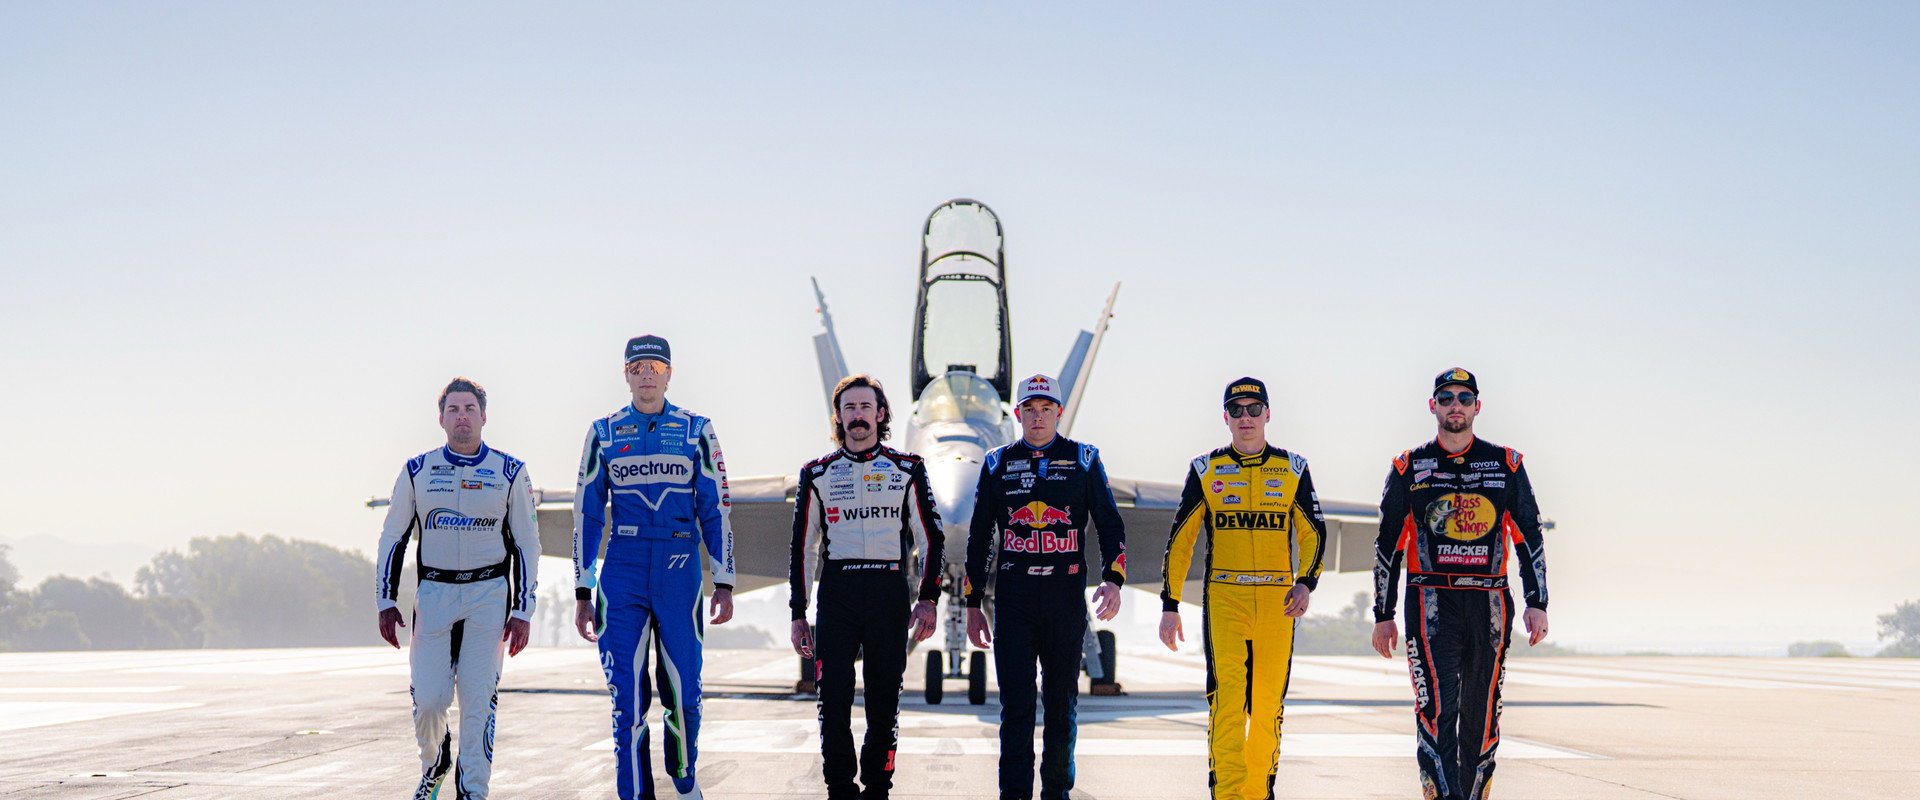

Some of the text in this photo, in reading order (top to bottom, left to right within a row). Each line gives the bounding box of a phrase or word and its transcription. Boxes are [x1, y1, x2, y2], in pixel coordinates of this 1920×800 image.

[632, 343, 662, 351] Spectrum
[611, 461, 684, 481] Spectrum
[1453, 494, 1480, 508] Bass
[843, 506, 900, 520] WÜRTH
[1454, 508, 1475, 520] Pro
[1454, 520, 1488, 536] Shops
[1004, 529, 1040, 553] Red
[1041, 529, 1078, 553] Bull
[1437, 545, 1488, 556] TRACKER
[668, 553, 690, 569] 77
[1407, 637, 1429, 709] TRACKER
